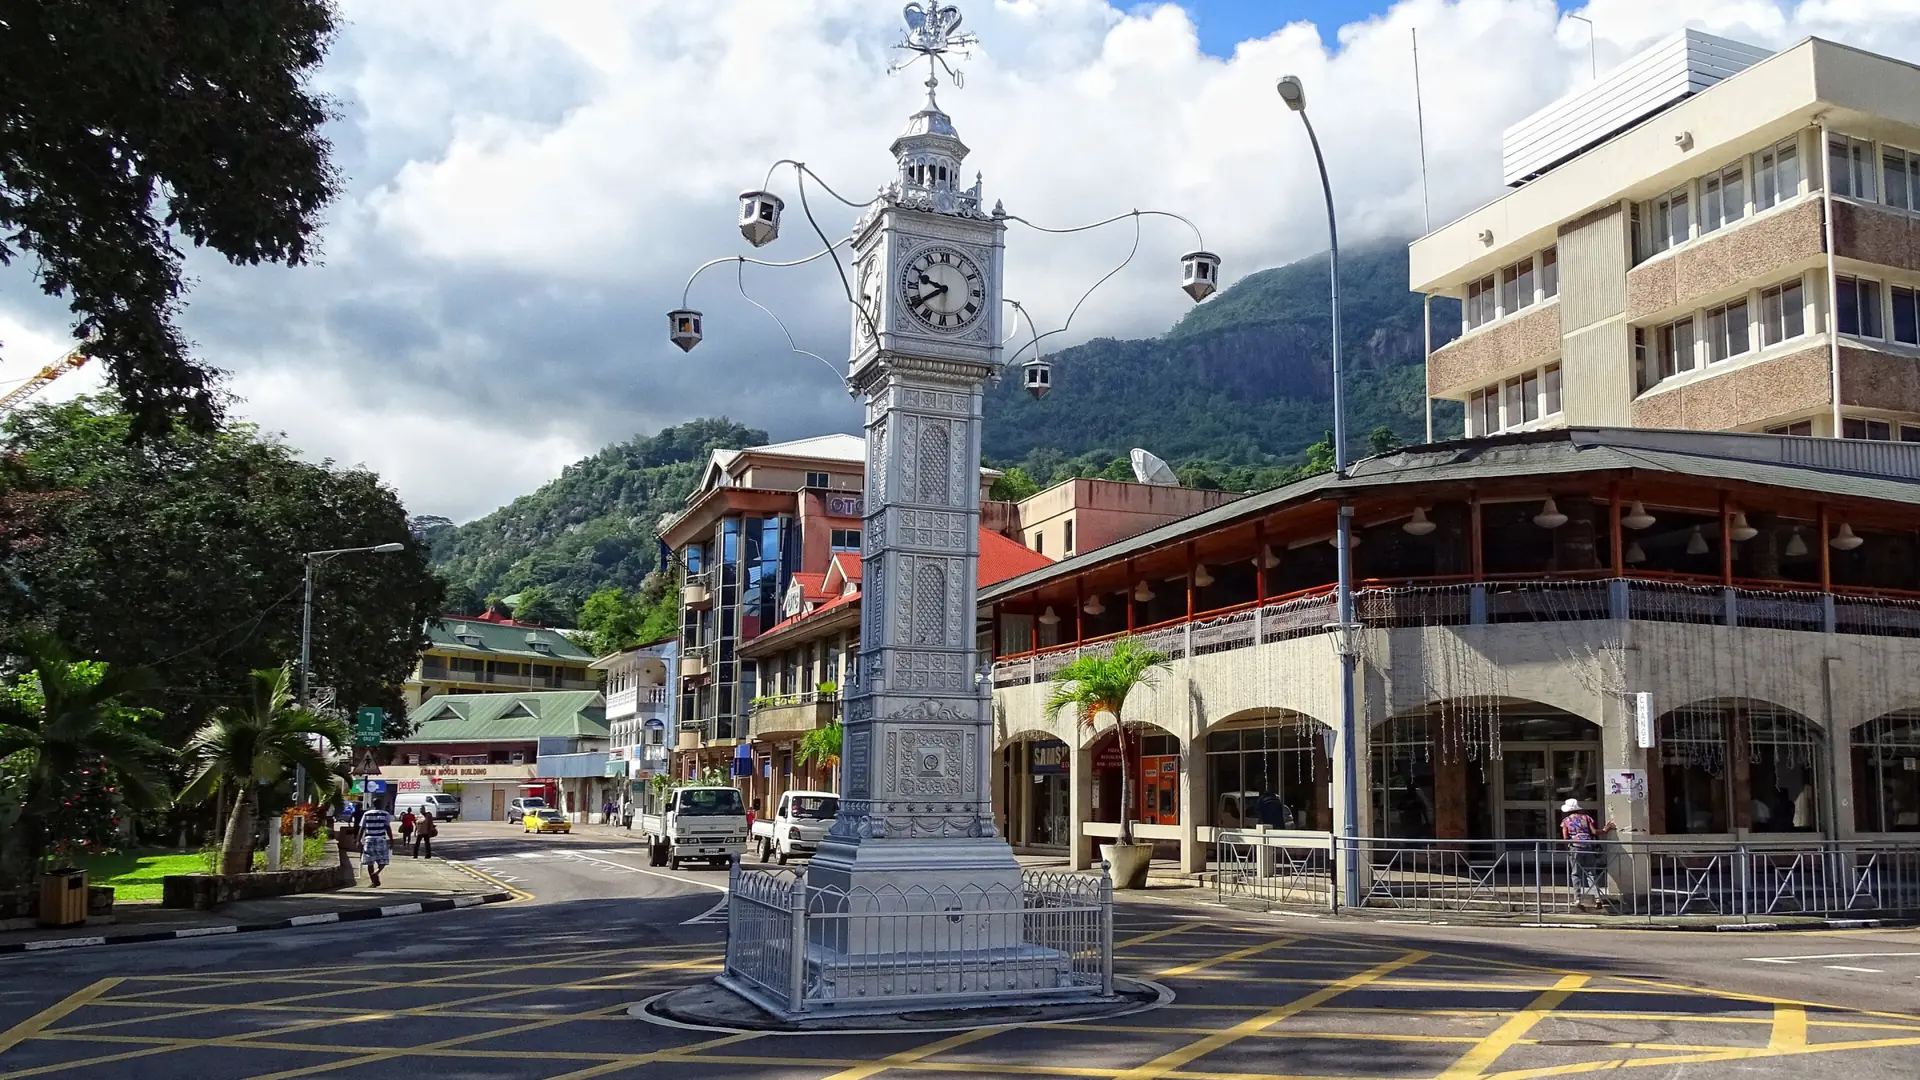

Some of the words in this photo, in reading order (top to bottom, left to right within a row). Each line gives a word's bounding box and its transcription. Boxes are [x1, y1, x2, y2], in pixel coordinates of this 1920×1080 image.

[1639, 695, 1647, 745] CHANGE
[420, 768, 437, 776] ADAM
[438, 768, 458, 776] MOOSA
[460, 768, 487, 776] BUILDING
